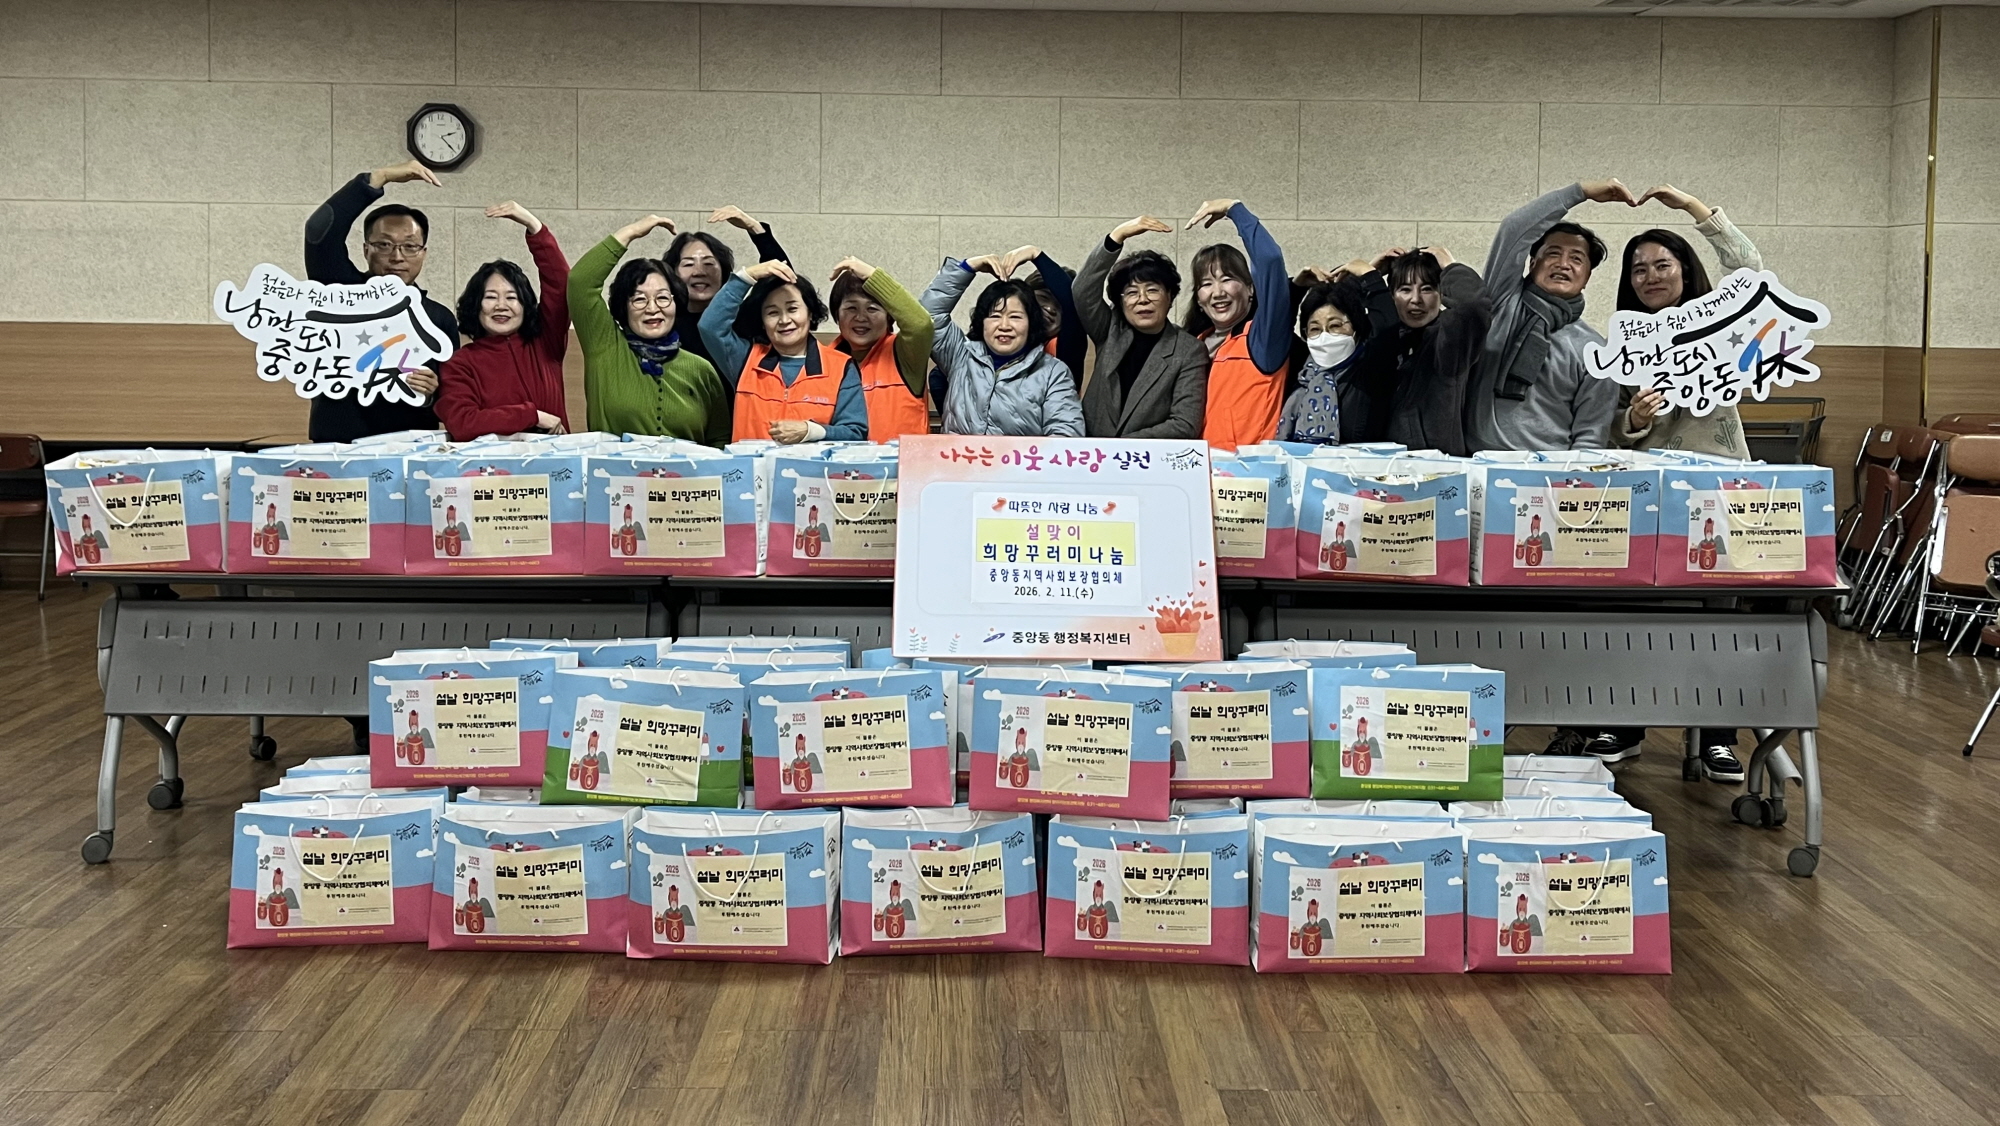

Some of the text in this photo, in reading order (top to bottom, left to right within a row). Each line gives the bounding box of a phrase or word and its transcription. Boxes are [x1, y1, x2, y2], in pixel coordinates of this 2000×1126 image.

[262, 273, 399, 307] 젊음과 쉼이 함께하는
[1619, 276, 1752, 341] 젊음과 쉼이 함께하는
[295, 326, 341, 352] 도시
[262, 338, 353, 394] 중앙동
[1673, 343, 1717, 377] 도시
[1652, 362, 1740, 411] 중앙동
[940, 445, 1151, 473] 나누는 이웃 사랑 실천
[293, 490, 366, 503] 설날 희망꾸러미
[474, 487, 548, 500] 설날 희망꾸러미
[648, 490, 721, 502] 설날 희망꾸러미
[835, 492, 854, 503] 설날
[1218, 489, 1266, 502] 희망꾸러미
[106, 497, 126, 508] 설날
[1009, 500, 1099, 514] 따뜻한 사랑 나눔
[1559, 501, 1579, 511] 설날
[1363, 510, 1434, 524] 설날 희망꾸러미
[989, 569, 1122, 584] 중앙동지역사회보장협의체
[1014, 586, 1094, 599] 2026. 2. 11.(수)
[1012, 631, 1130, 646] 중앙동 행정복지센터
[436, 692, 516, 705] 설날 희망꾸러미
[1191, 705, 1268, 718] 설날 희망꾸러미
[1387, 702, 1467, 718] 설날 희망꾸러미
[824, 710, 905, 728] 설날 희망꾸러미
[1047, 713, 1129, 730] 설날 희망꾸러미
[620, 717, 701, 738] 설날 희망꾸러미
[303, 852, 325, 865] 설날
[496, 860, 582, 877] 설날 희망꾸러미
[921, 865, 943, 878] 설날
[1124, 867, 1147, 880] 설날
[697, 871, 720, 884] 설날
[1340, 878, 1422, 895] 설날 희망꾸러미
[1549, 879, 1572, 891] 설날
